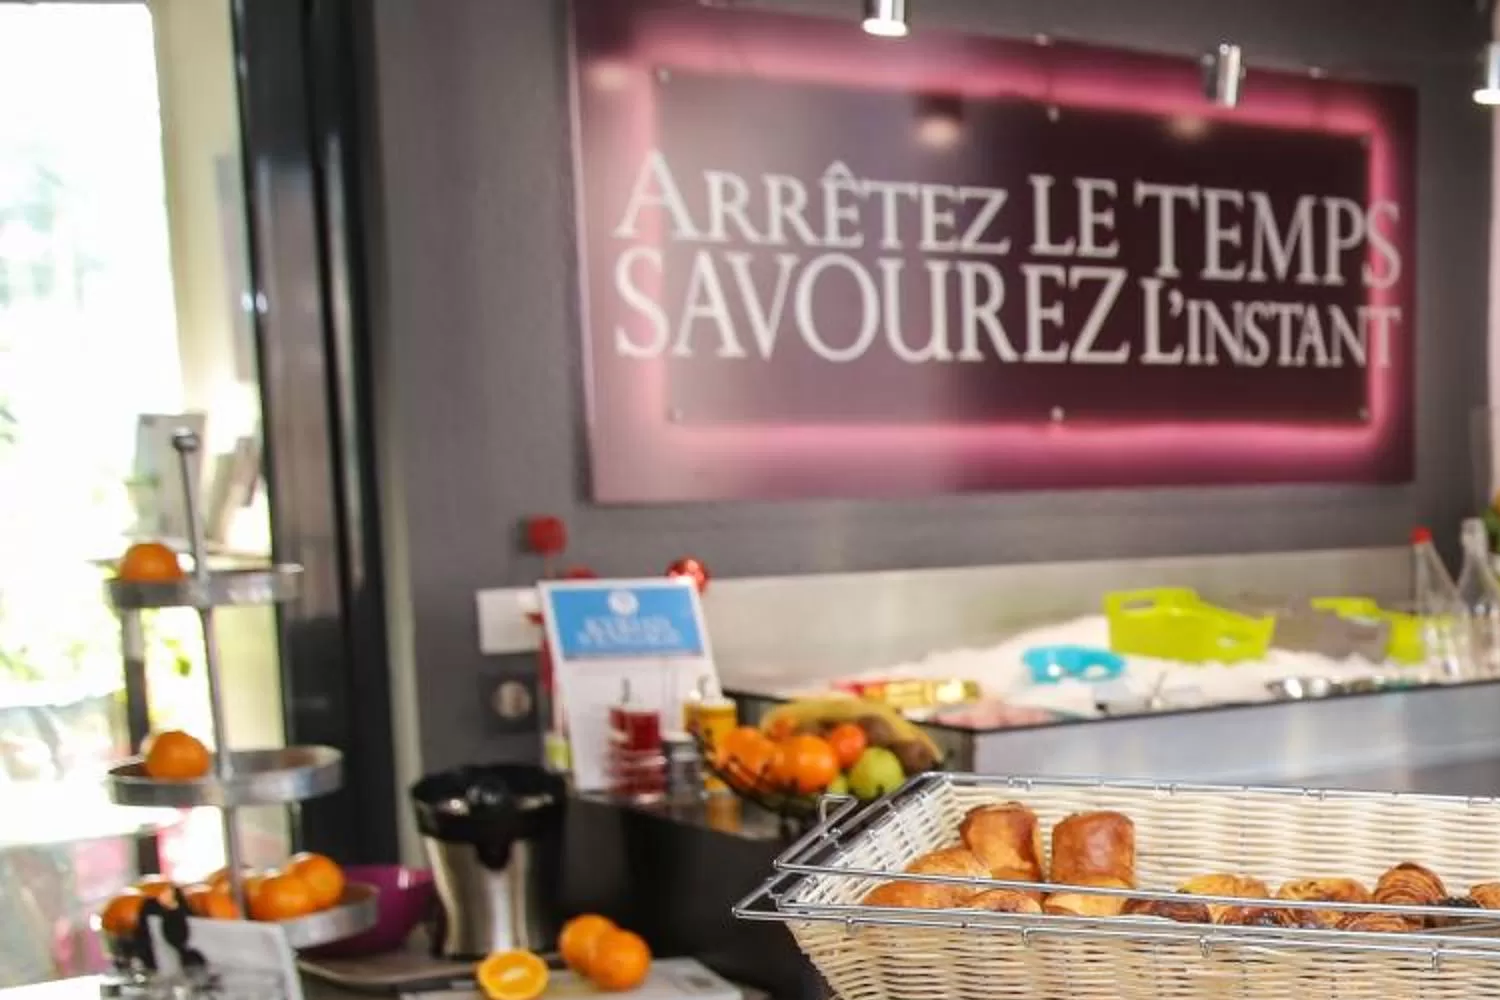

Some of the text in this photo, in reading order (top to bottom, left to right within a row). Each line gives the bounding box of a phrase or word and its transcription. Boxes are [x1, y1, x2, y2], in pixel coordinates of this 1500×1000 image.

[614, 149, 1401, 290] ARRÊTEZ LE TEMPS
[613, 247, 1401, 369] SAVOUREZ L'INSTANT
